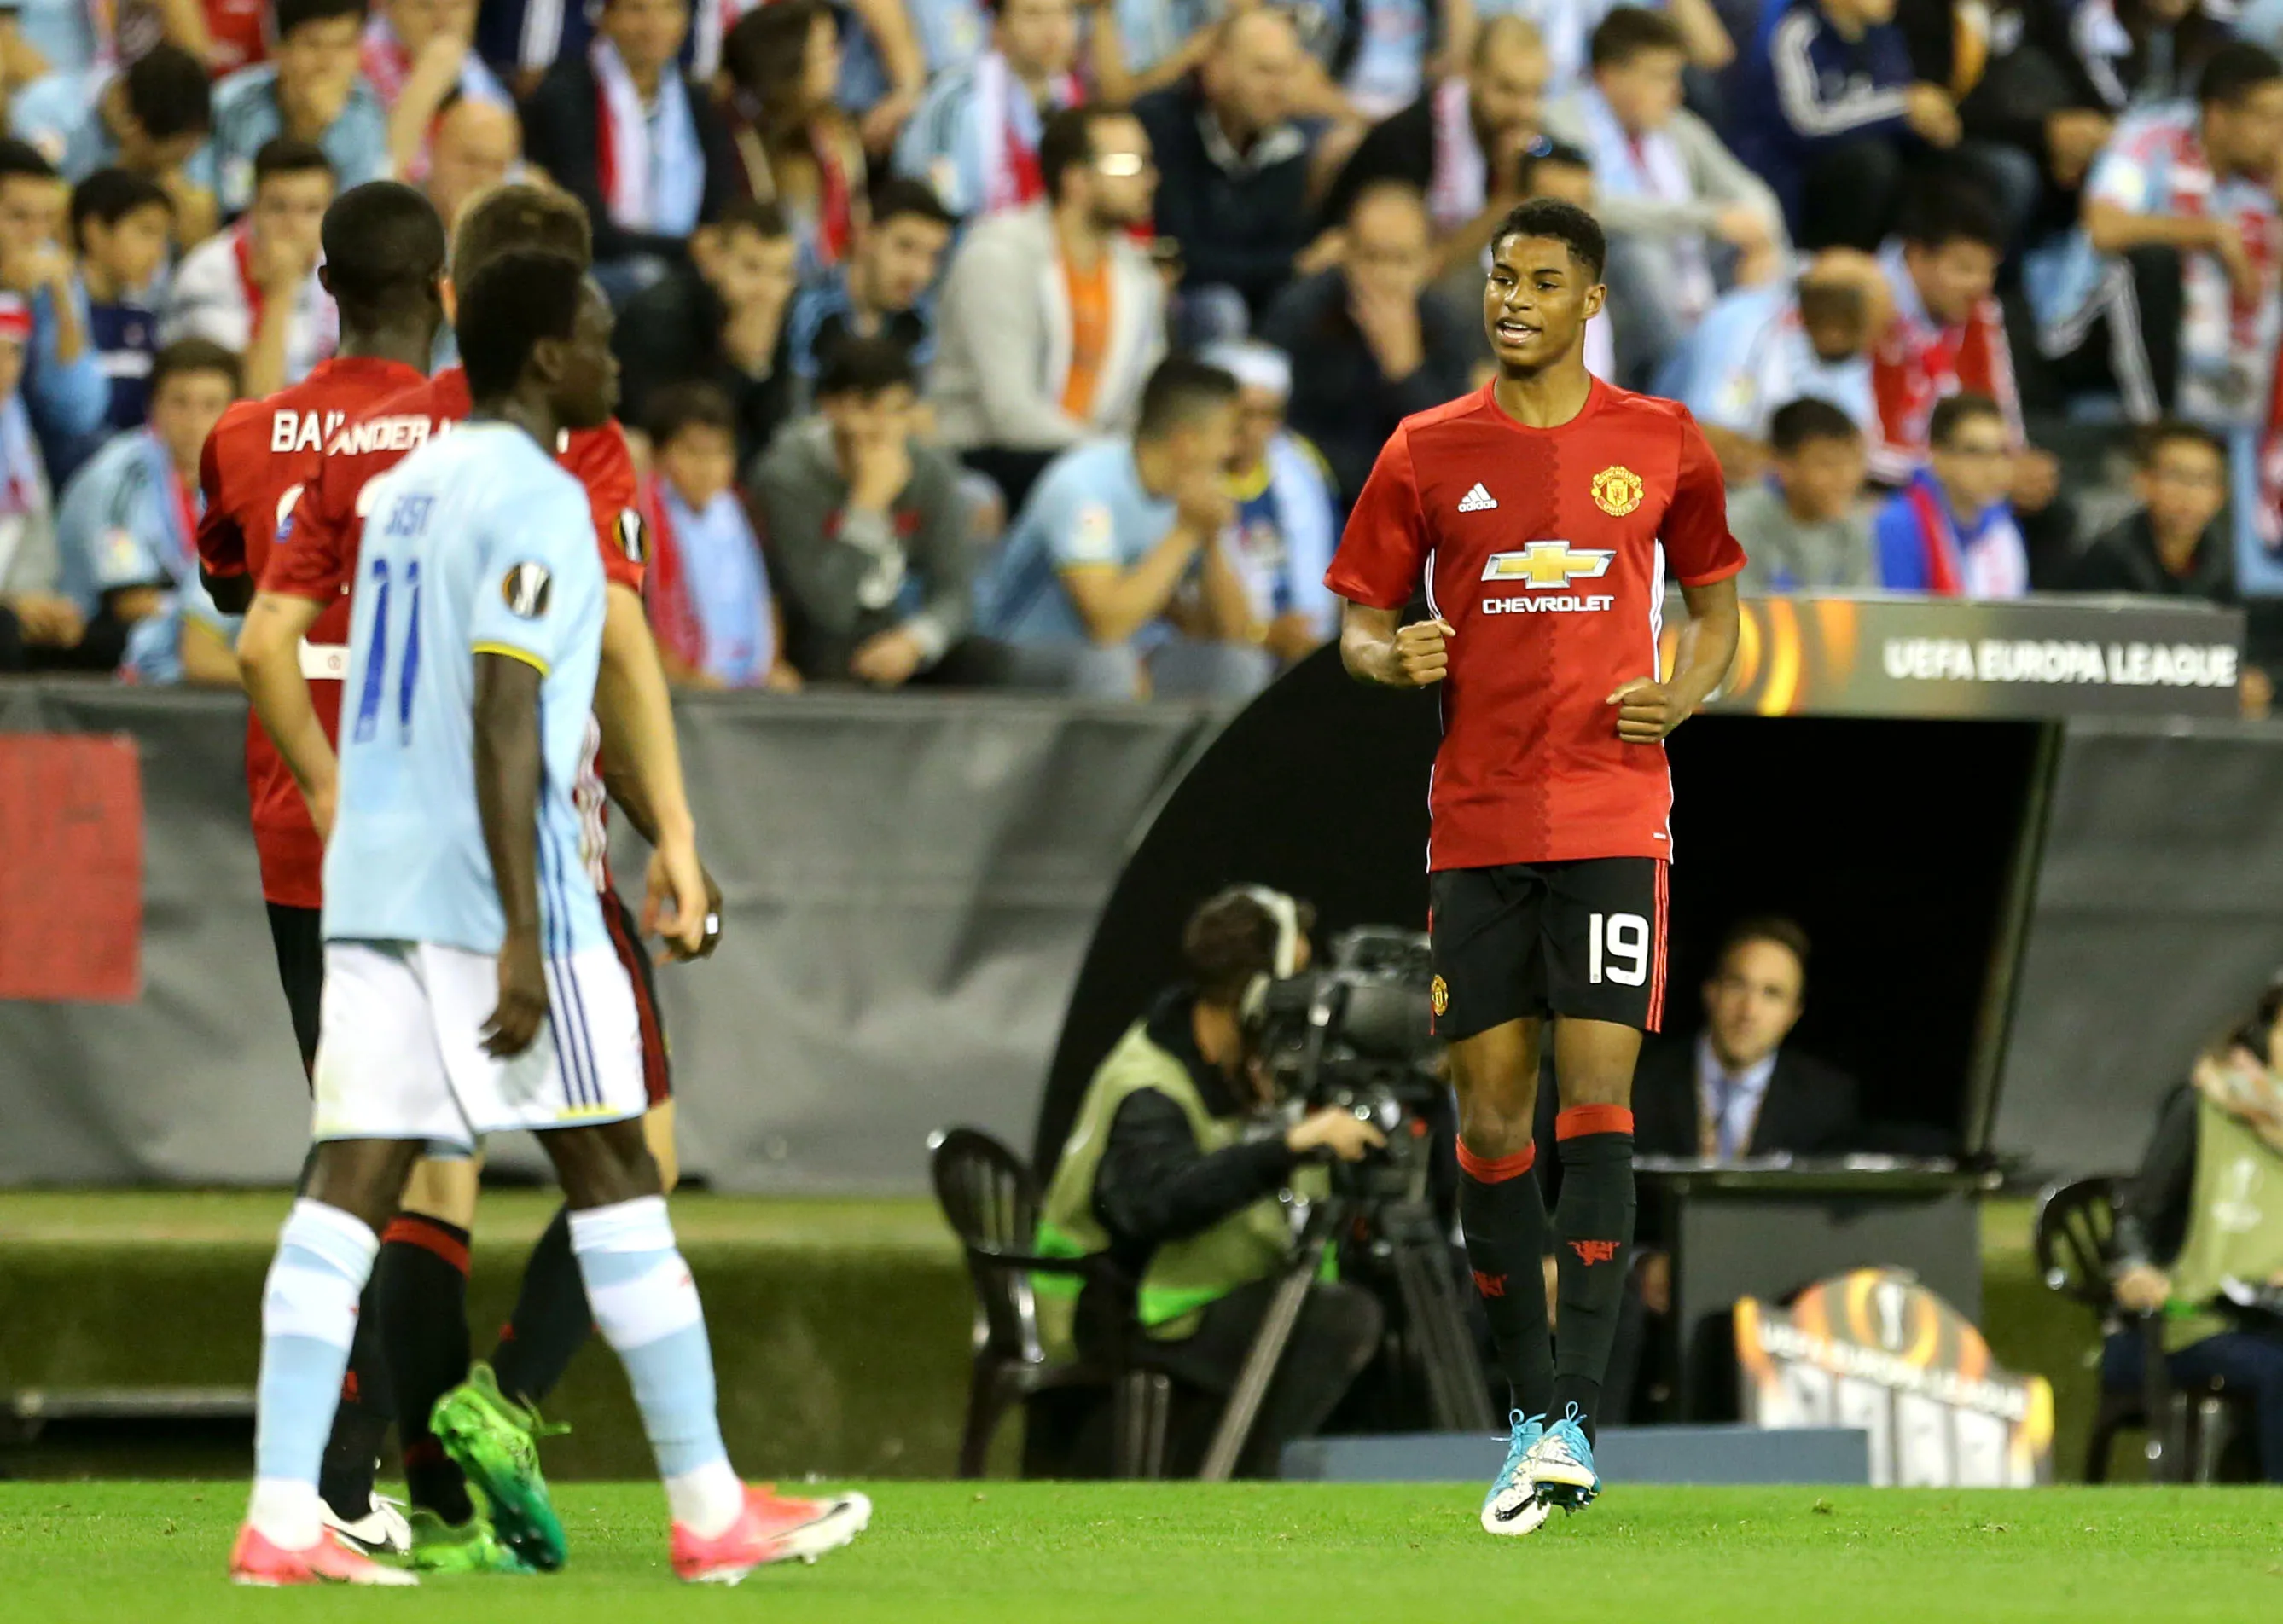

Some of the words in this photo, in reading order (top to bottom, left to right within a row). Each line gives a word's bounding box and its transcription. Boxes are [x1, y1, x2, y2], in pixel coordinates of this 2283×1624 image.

[1458, 499, 1498, 513] adidas
[1483, 596, 1615, 614] CHEVROLET
[352, 558, 420, 748] 11
[1883, 638, 1975, 680] UEFA
[1977, 639, 2106, 683] EUROPA
[2107, 642, 2238, 687] LEAGUE
[1589, 913, 1650, 987] 19
